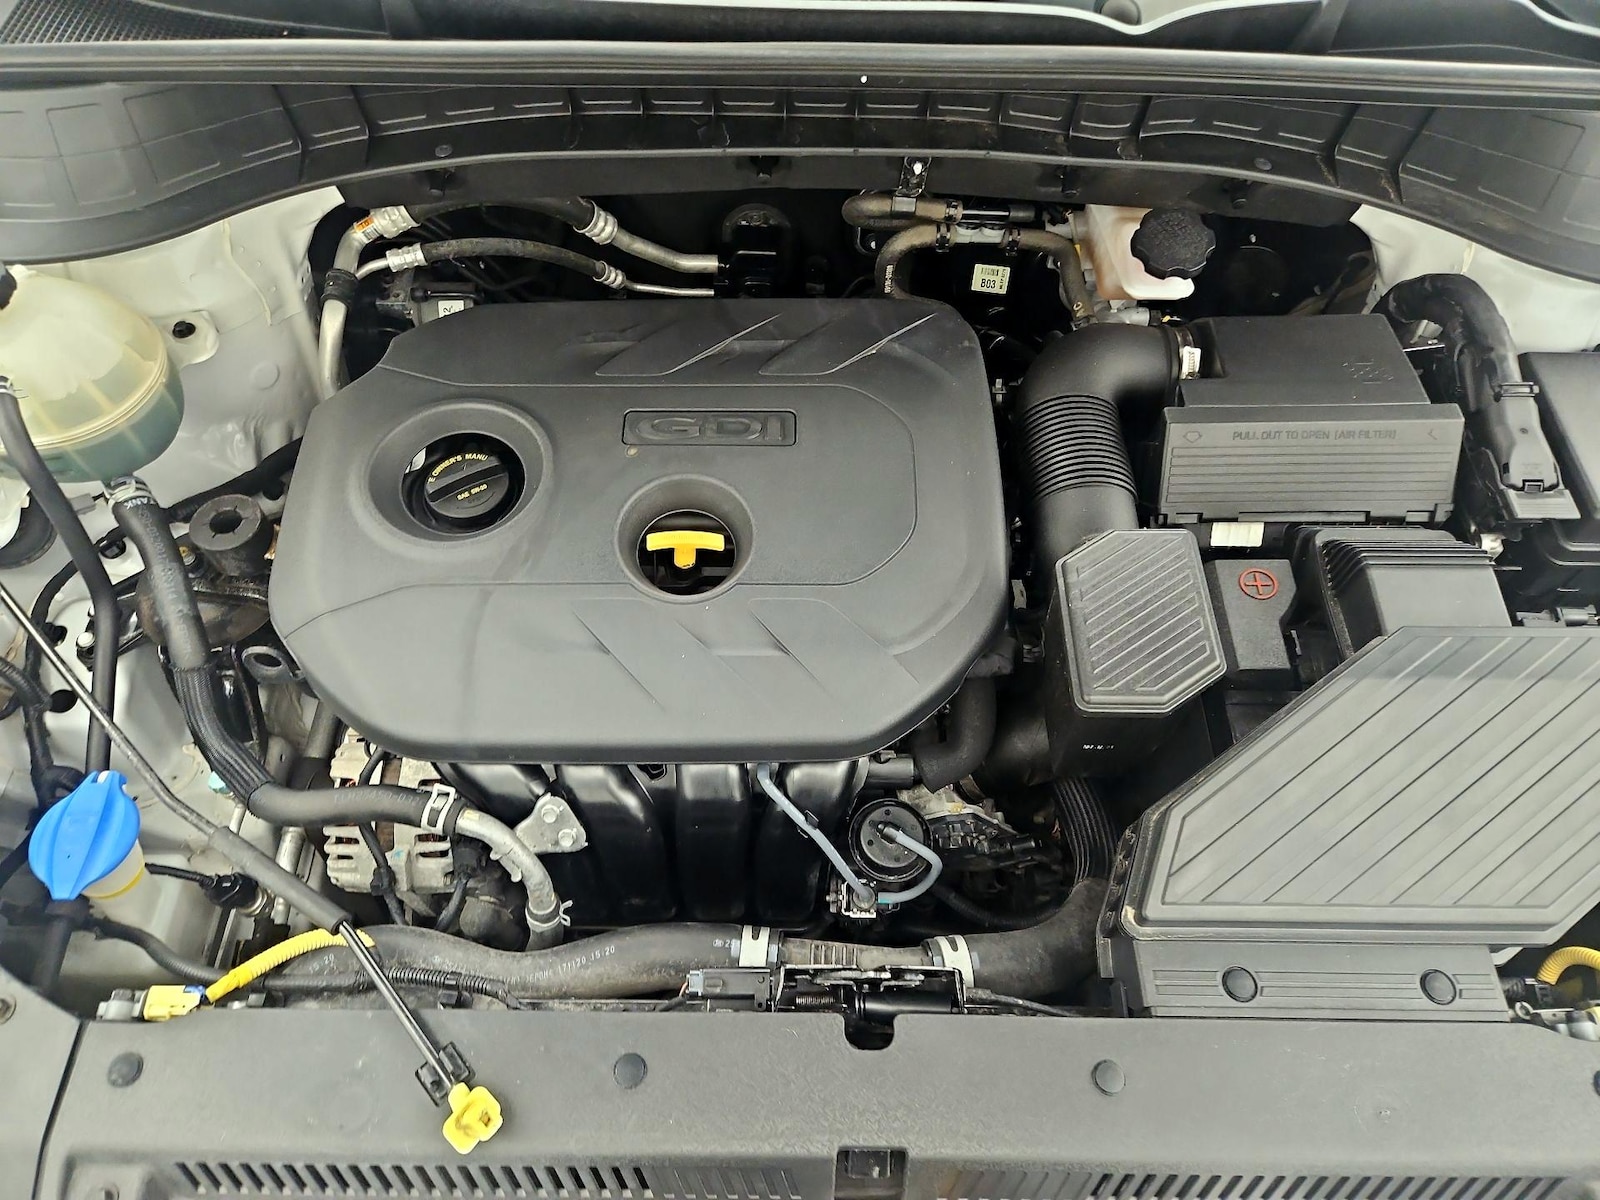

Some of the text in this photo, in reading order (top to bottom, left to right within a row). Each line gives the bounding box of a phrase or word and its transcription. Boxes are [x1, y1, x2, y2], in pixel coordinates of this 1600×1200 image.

[981, 278, 996, 289] B03
[633, 415, 784, 441] GDI
[1232, 431, 1259, 441] PULL
[1260, 430, 1283, 440] OUT
[1285, 430, 1299, 440] TO
[1301, 430, 1330, 440] OPEN
[465, 453, 488, 461] MANU
